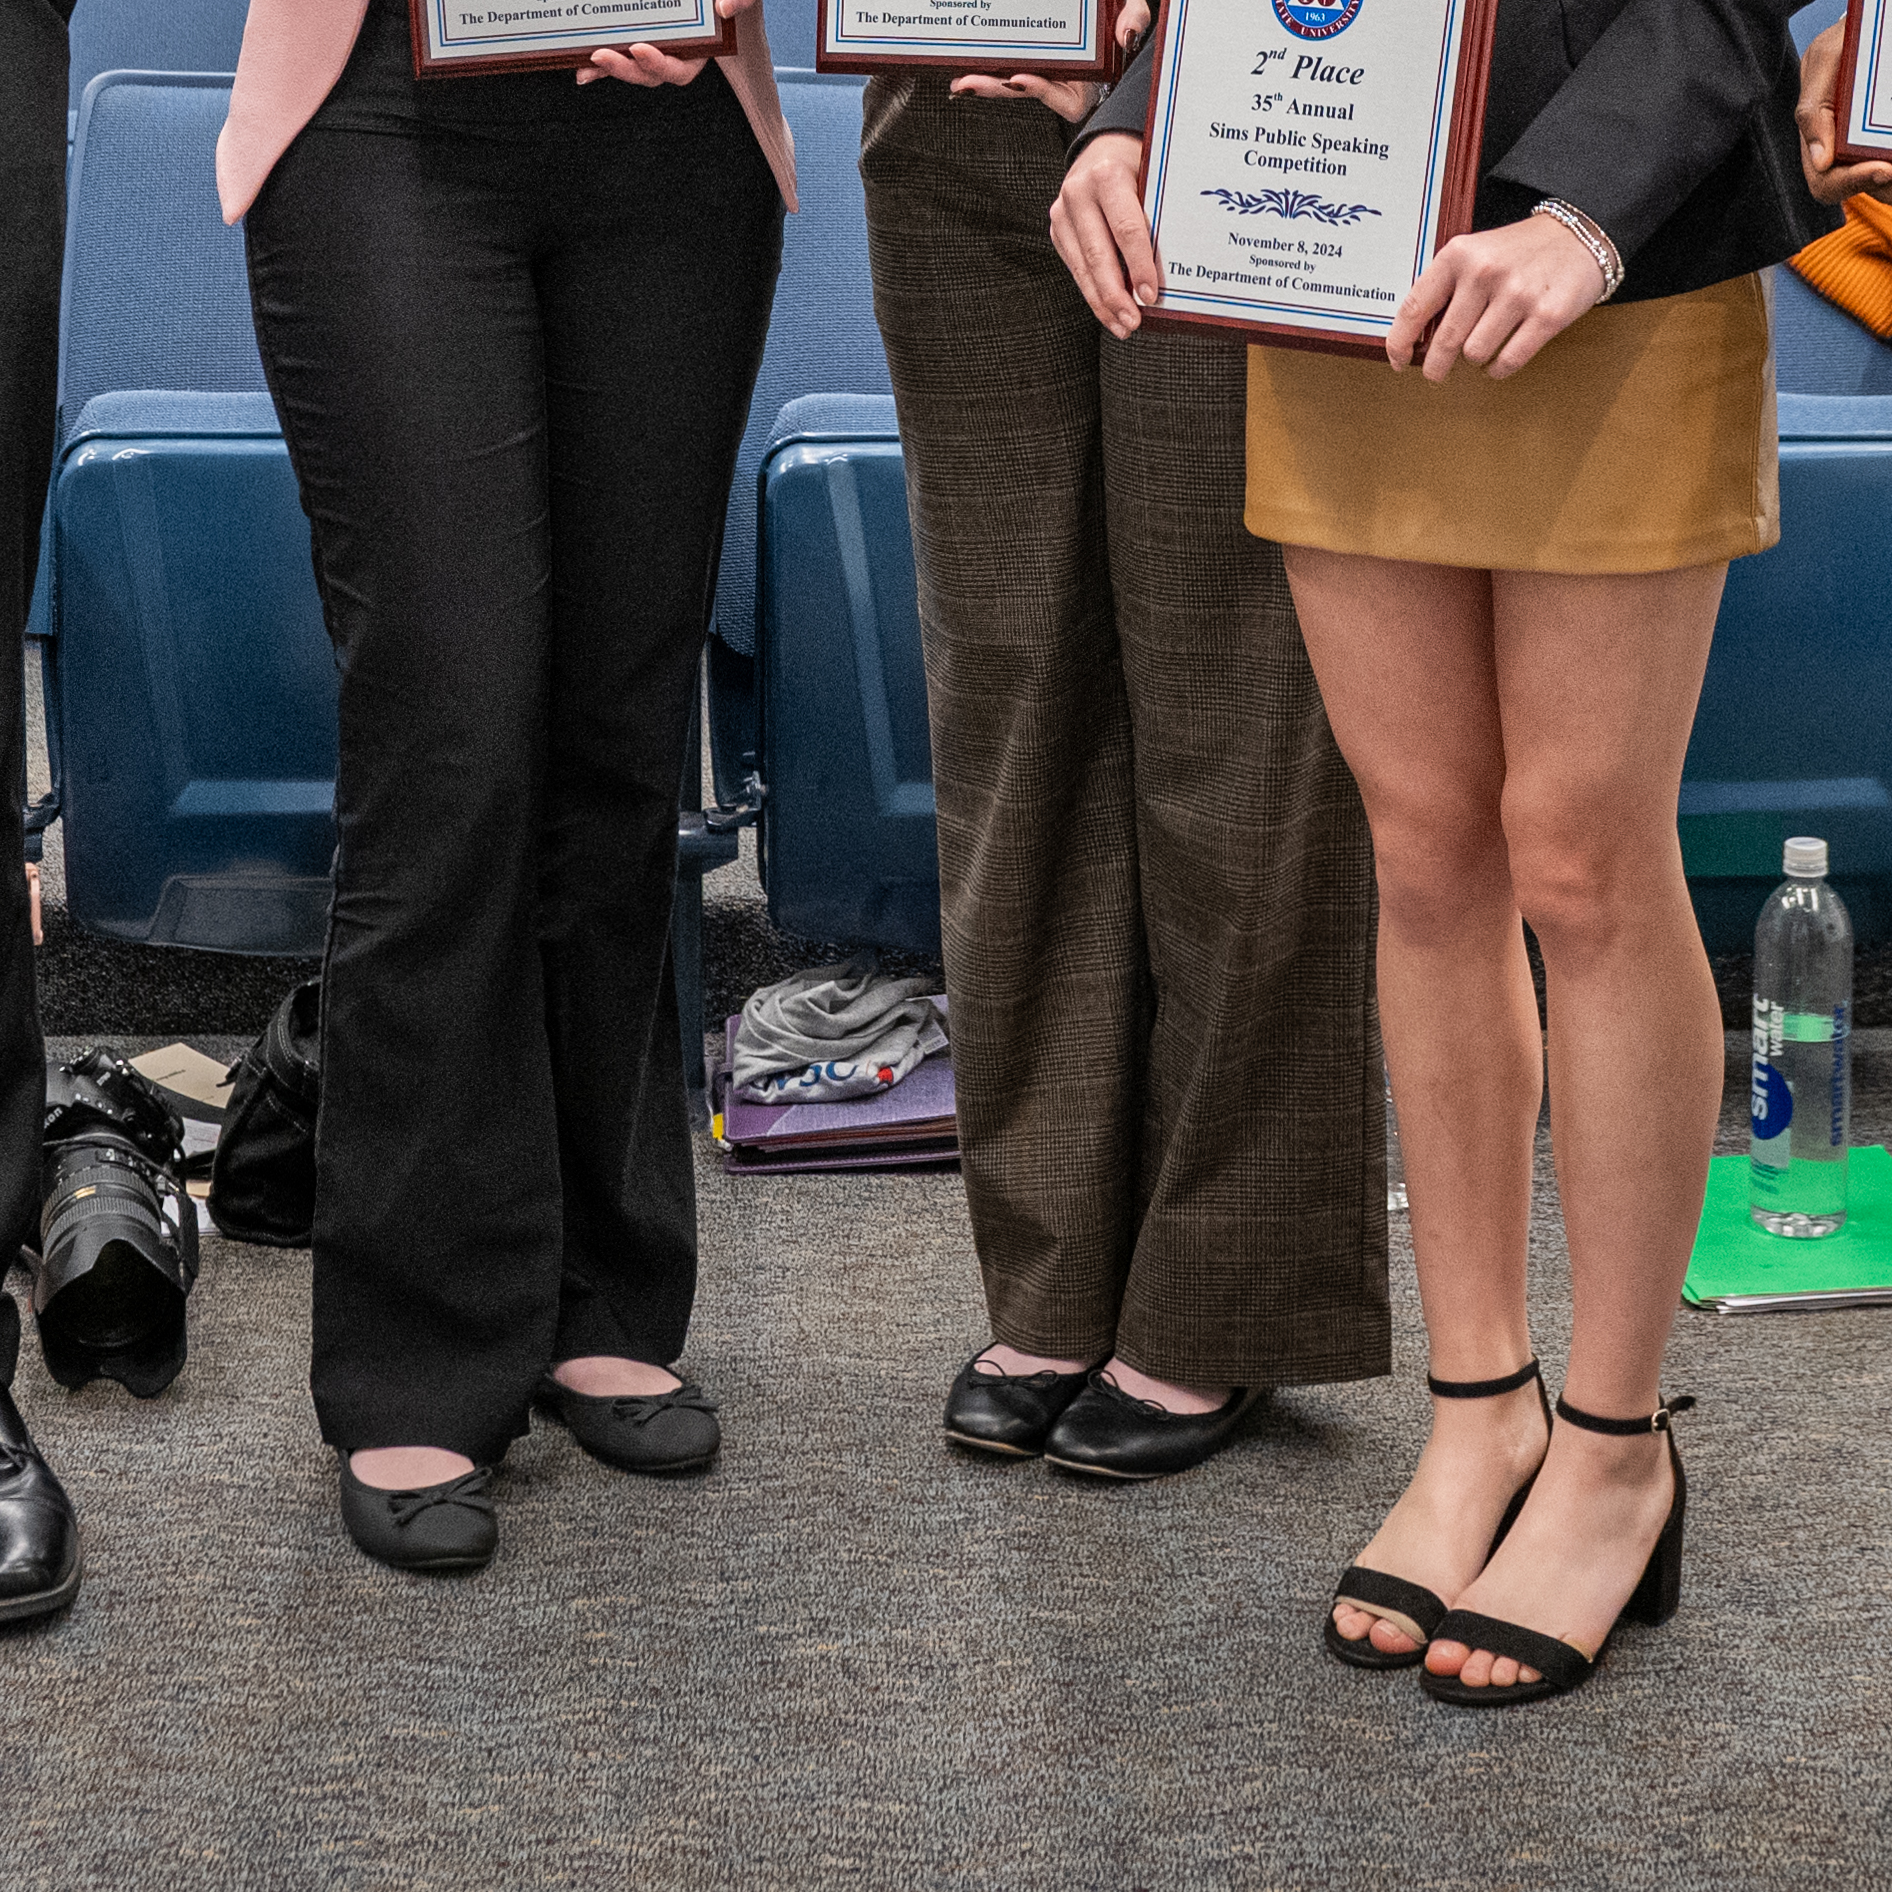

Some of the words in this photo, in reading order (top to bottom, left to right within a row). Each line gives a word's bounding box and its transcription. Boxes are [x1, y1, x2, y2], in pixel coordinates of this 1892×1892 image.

[459, 13, 484, 25] The
[487, 7, 562, 25] Department
[565, 4, 580, 17] of
[856, 11, 879, 24] The
[882, 12, 953, 27] Department
[955, 14, 969, 26] of
[970, 14, 1067, 29] Communication
[980, 0, 992, 12] by
[1300, 0, 1360, 37] UNIVERSITY
[1304, 12, 1326, 23] 1963
[1250, 48, 1288, 76] 2nd
[1290, 54, 1365, 86] Place
[1251, 92, 1283, 112] 35th
[1286, 98, 1355, 121] Annual
[1209, 122, 1249, 141] Sims
[1254, 126, 1307, 148] Public
[1311, 132, 1389, 161] Speaking
[1243, 149, 1347, 176] Competition
[1228, 232, 1295, 252] November
[1296, 240, 1309, 256] 8,
[1312, 242, 1343, 258] 2024
[1248, 254, 1302, 271] Sponsored
[1303, 260, 1315, 275] by
[1170, 261, 1193, 277] The
[1195, 264, 1272, 287] Department
[1275, 275, 1290, 289] of
[1291, 277, 1396, 302] Communication
[1769, 1001, 1784, 1056] water
[1751, 993, 1768, 1121] smart
